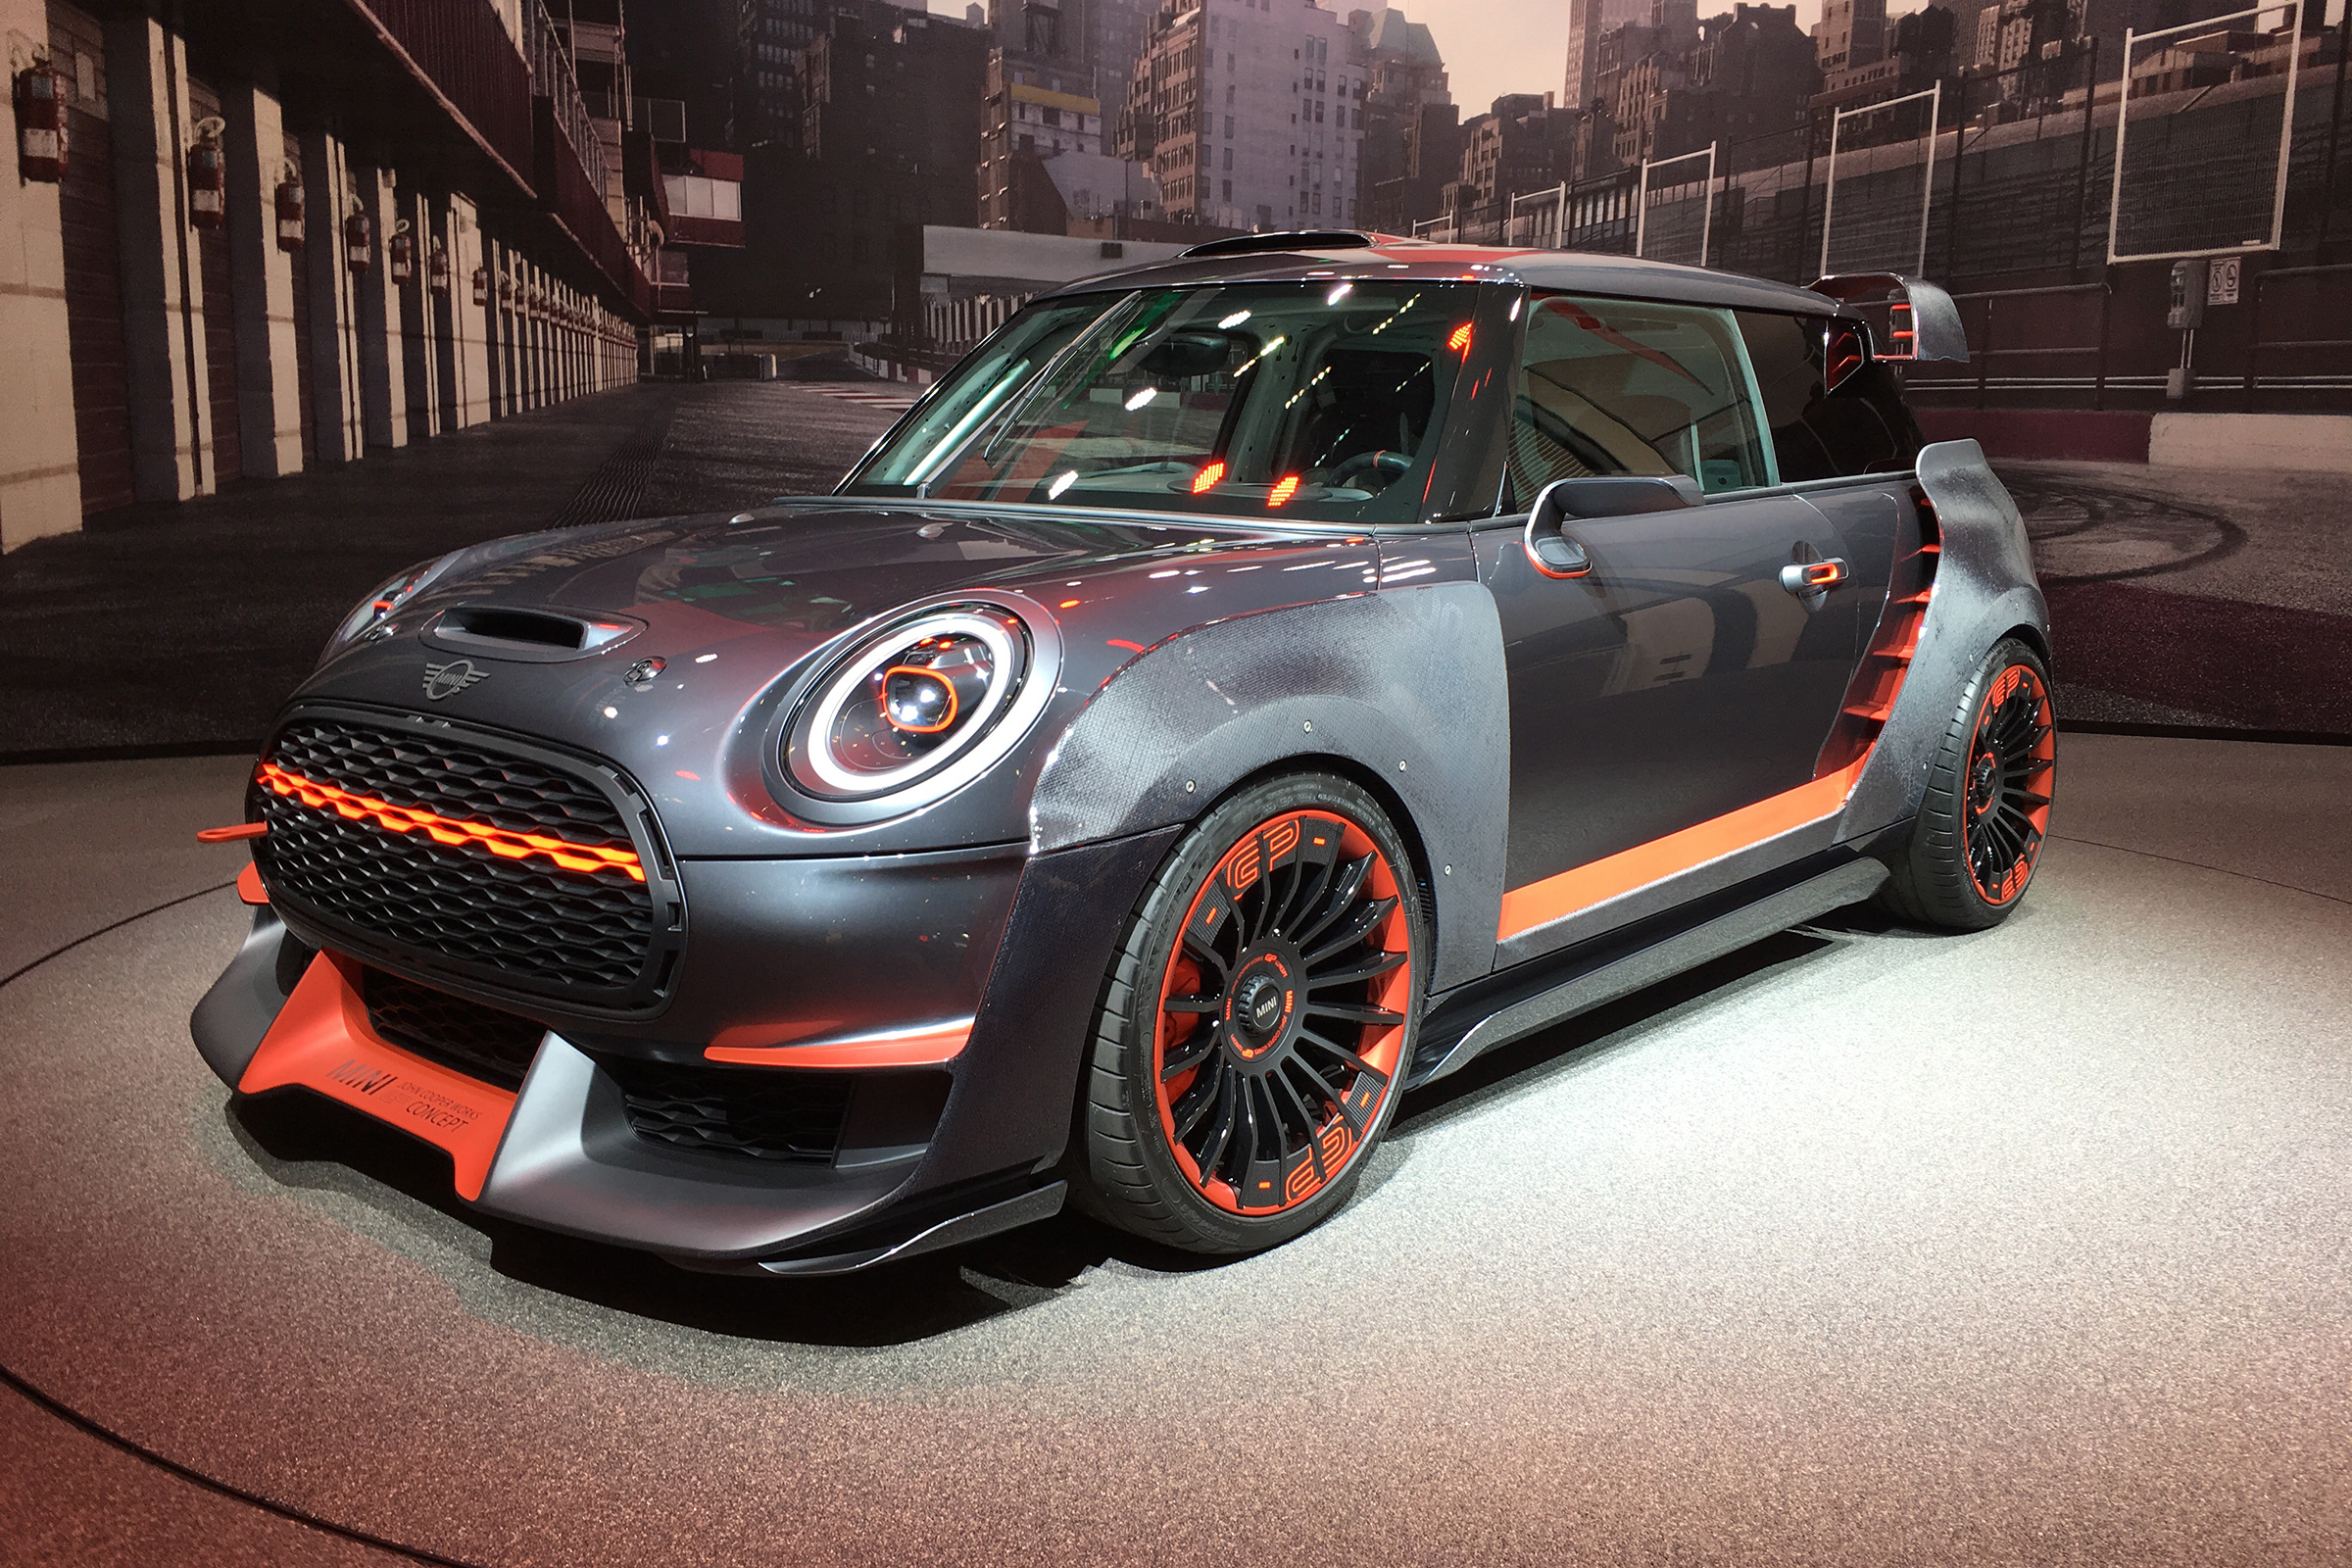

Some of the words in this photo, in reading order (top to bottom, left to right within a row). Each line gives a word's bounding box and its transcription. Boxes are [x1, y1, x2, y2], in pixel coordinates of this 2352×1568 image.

[435, 672, 464, 685] MINI
[1226, 819, 1300, 901] GP
[1264, 953, 1278, 962] GP
[1255, 996, 1277, 1018] MINI
[1285, 990, 1294, 1013] MINI
[1241, 1049, 1254, 1058] GP
[325, 1059, 398, 1096] MINI
[397, 1081, 422, 1095] JOHN
[418, 1090, 455, 1107] COOPER
[451, 1103, 482, 1121] WORKS
[406, 1101, 468, 1132] CONCEPT
[1286, 1114, 1353, 1200] GP
